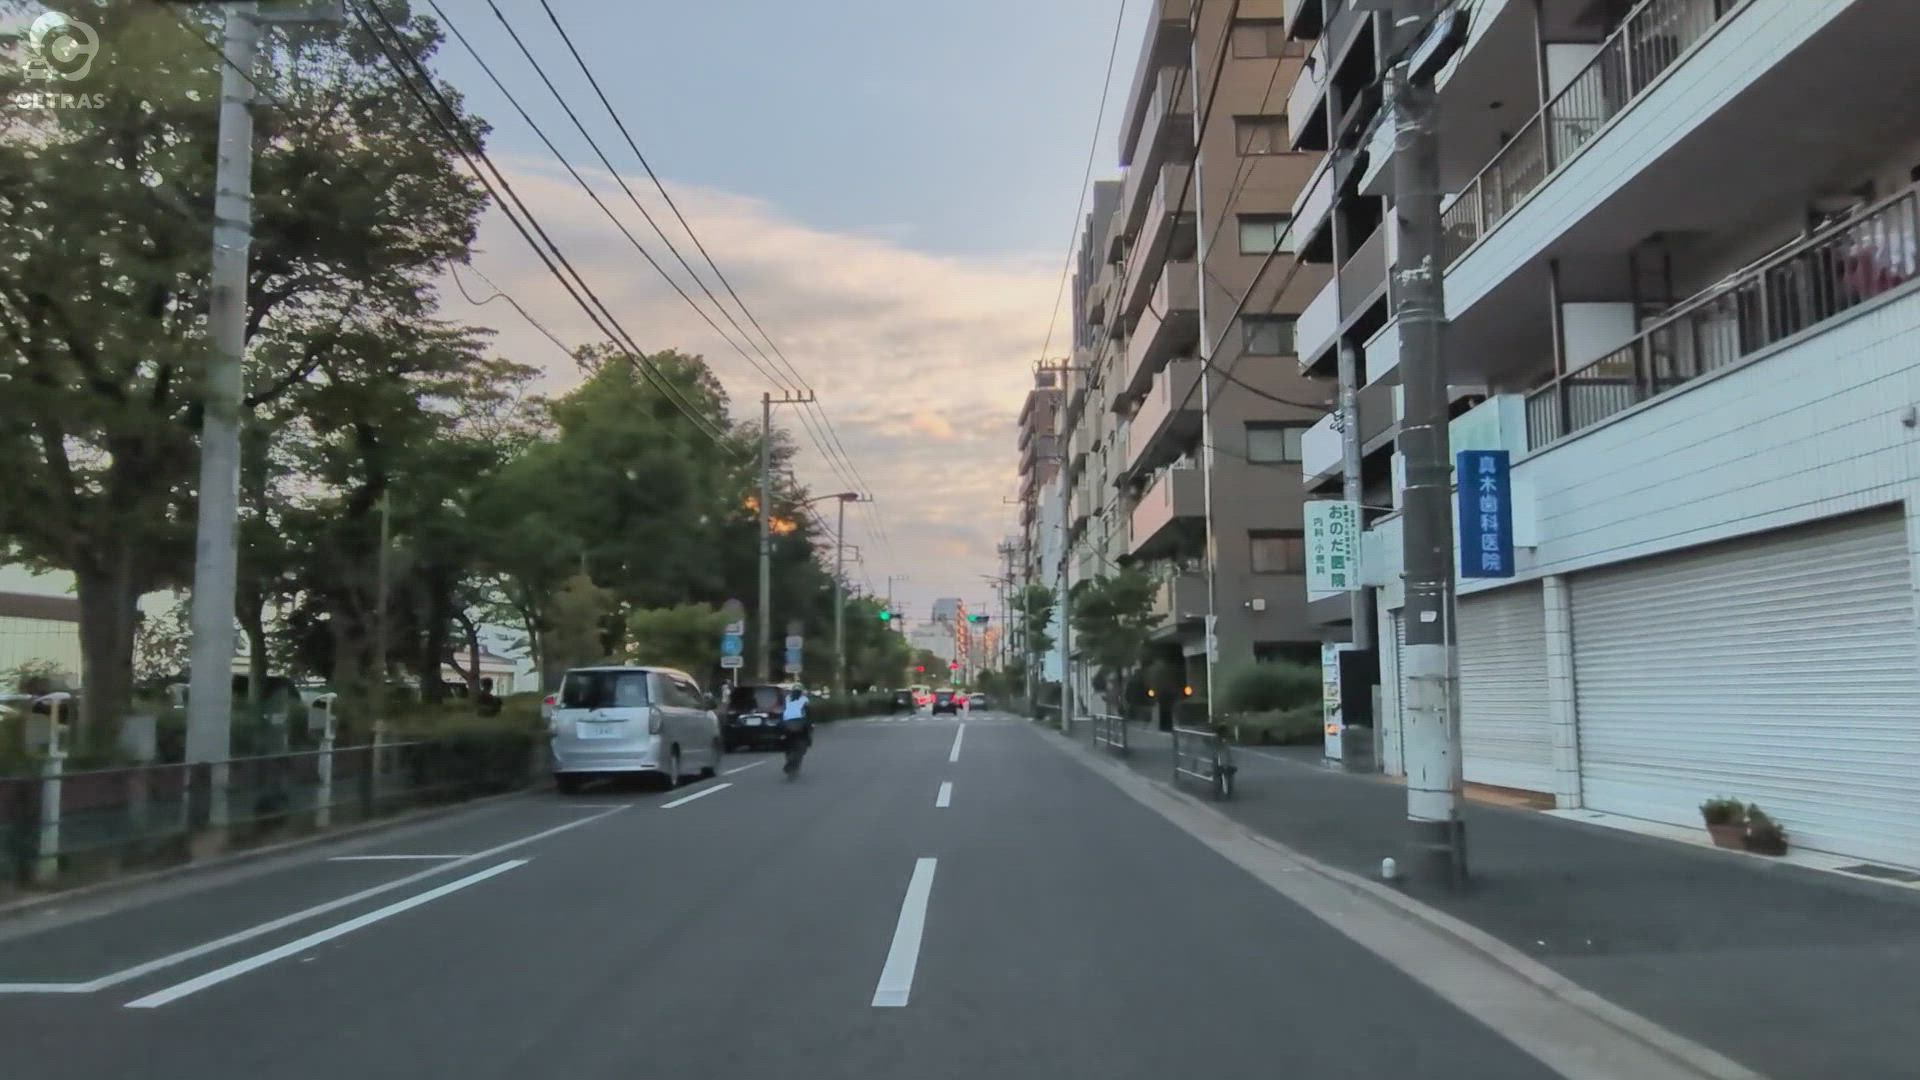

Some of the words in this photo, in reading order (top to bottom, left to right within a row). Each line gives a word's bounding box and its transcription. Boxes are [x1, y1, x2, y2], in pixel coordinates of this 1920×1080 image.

[1329, 505, 1346, 588] おのだ医院
[1479, 456, 1501, 570] 真木歯科医院
